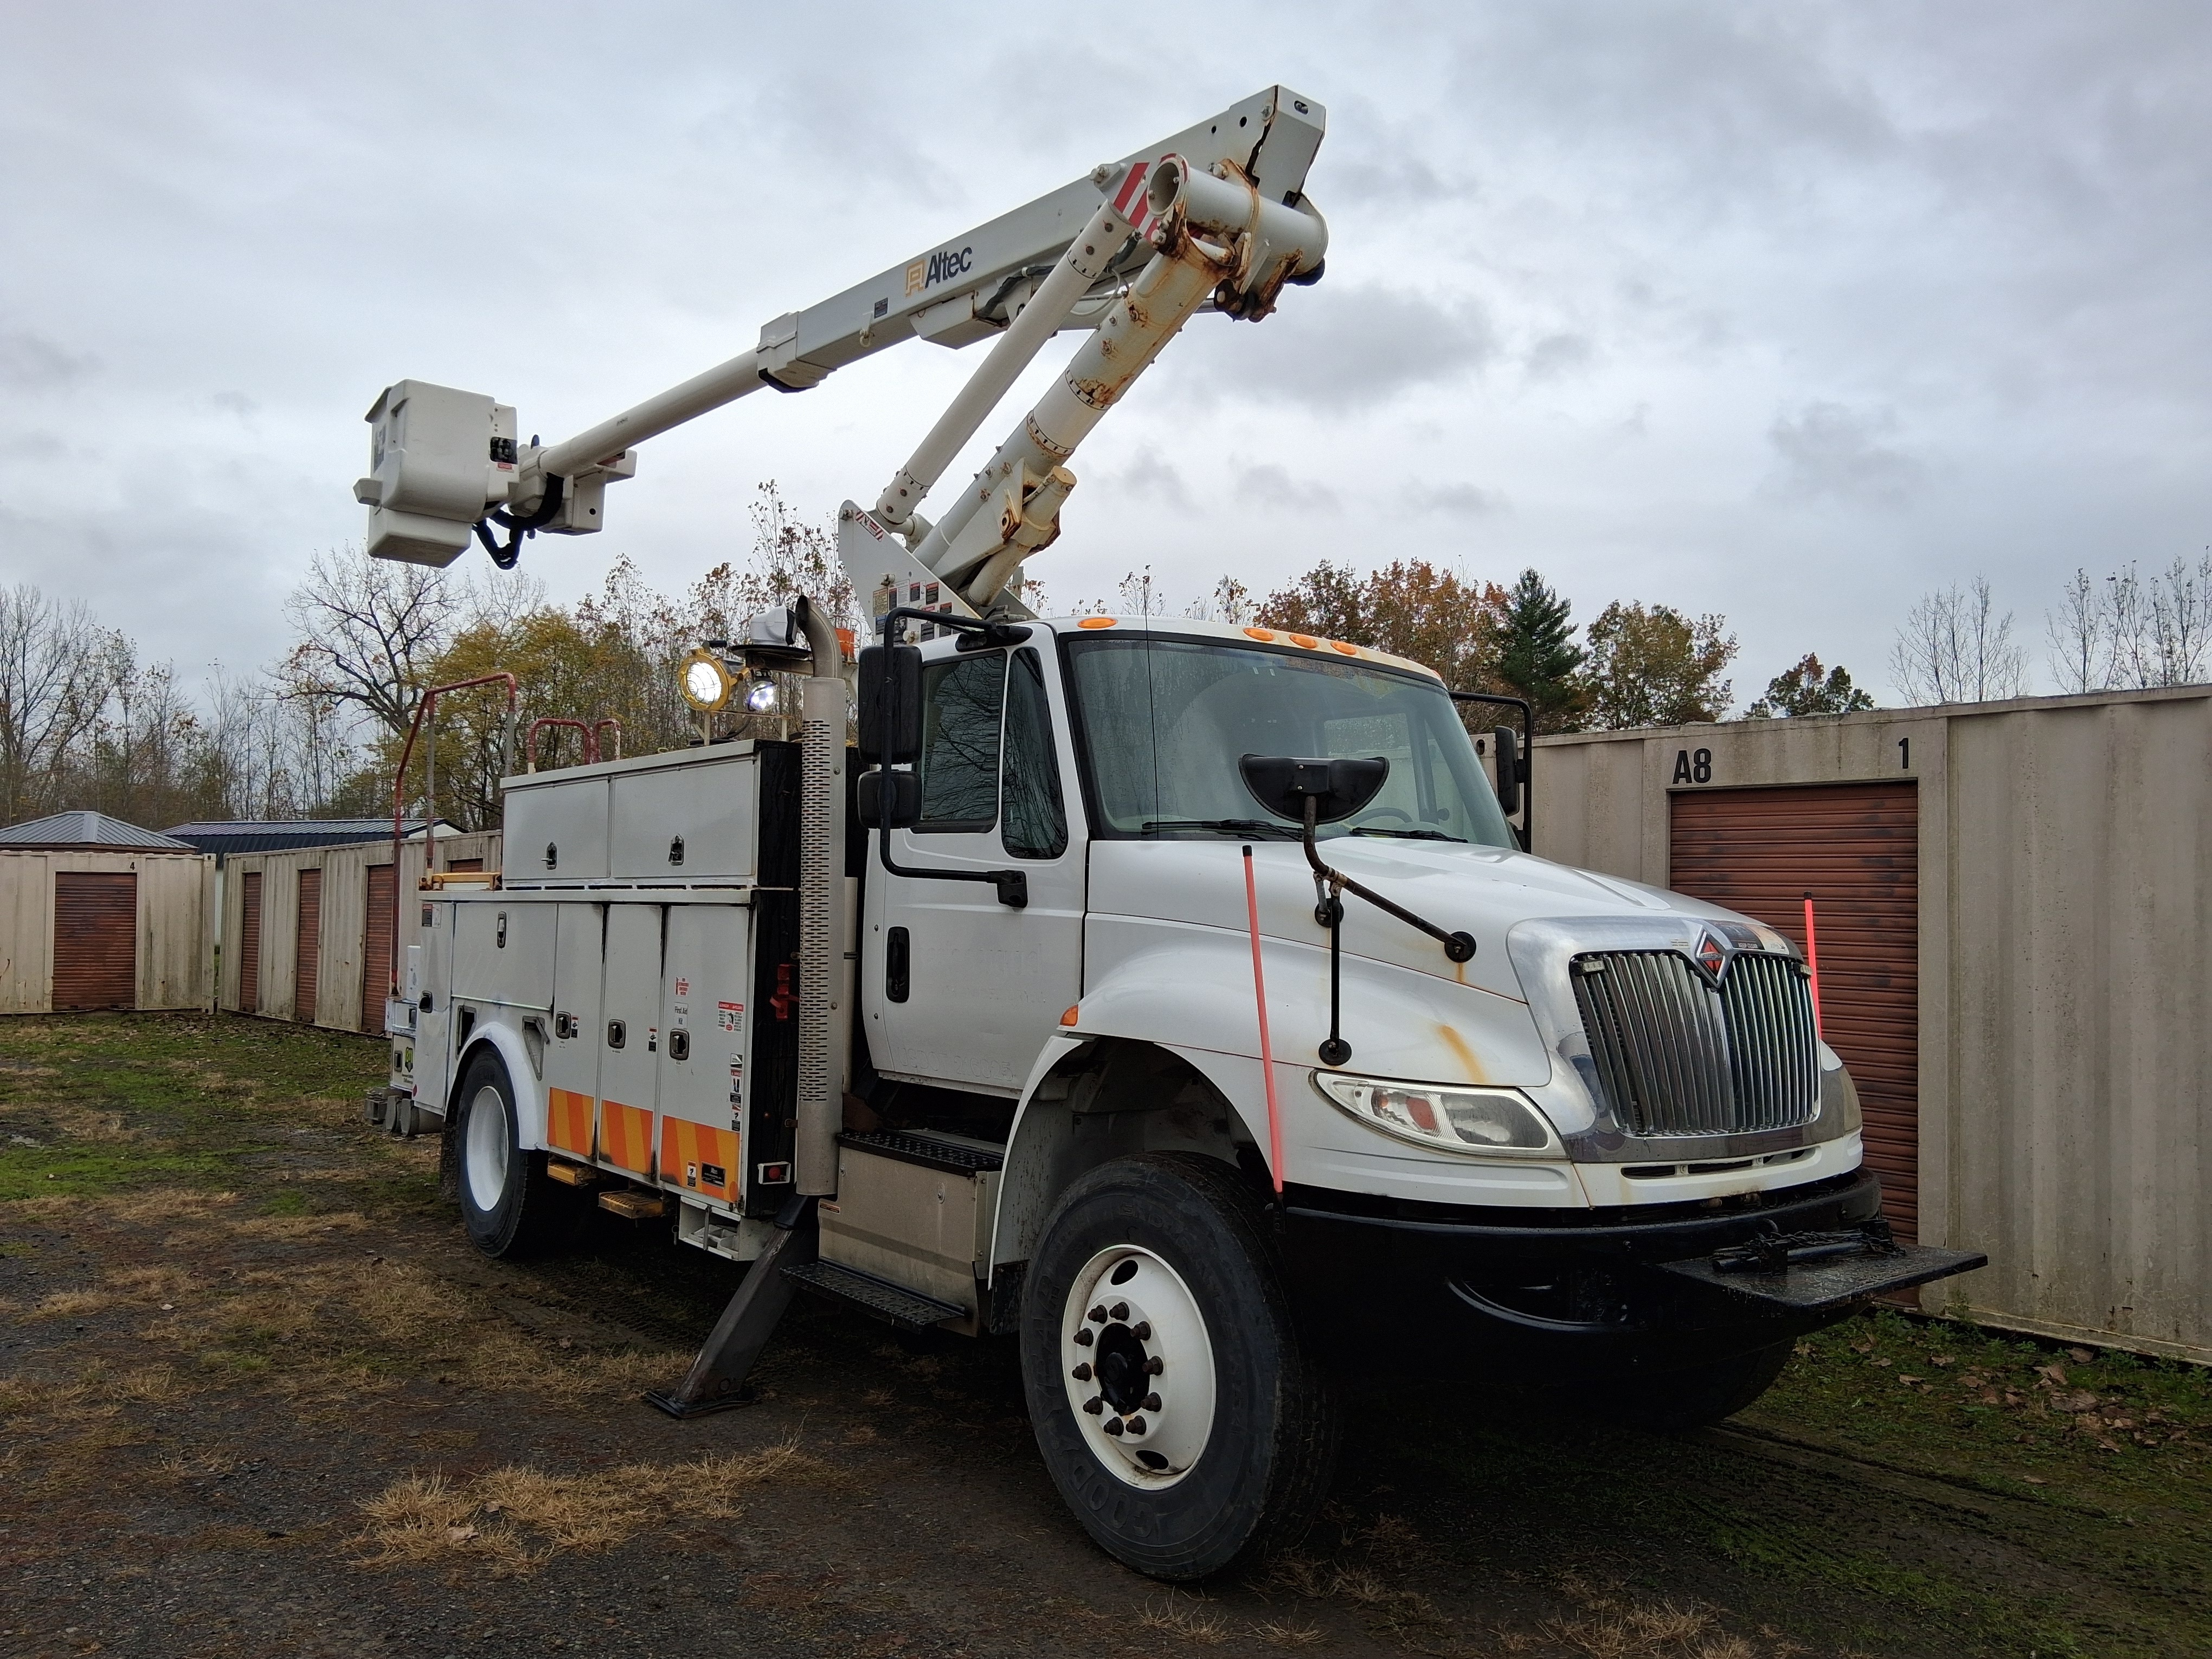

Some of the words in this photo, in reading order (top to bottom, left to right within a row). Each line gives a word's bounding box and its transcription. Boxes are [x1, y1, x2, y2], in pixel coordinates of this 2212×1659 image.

[925, 247, 972, 289] Altec
[1672, 748, 1711, 784] A8
[1898, 737, 1909, 769] 1
[130, 861, 136, 870] 4
[1033, 1274, 1153, 1538] GOODYEAR
